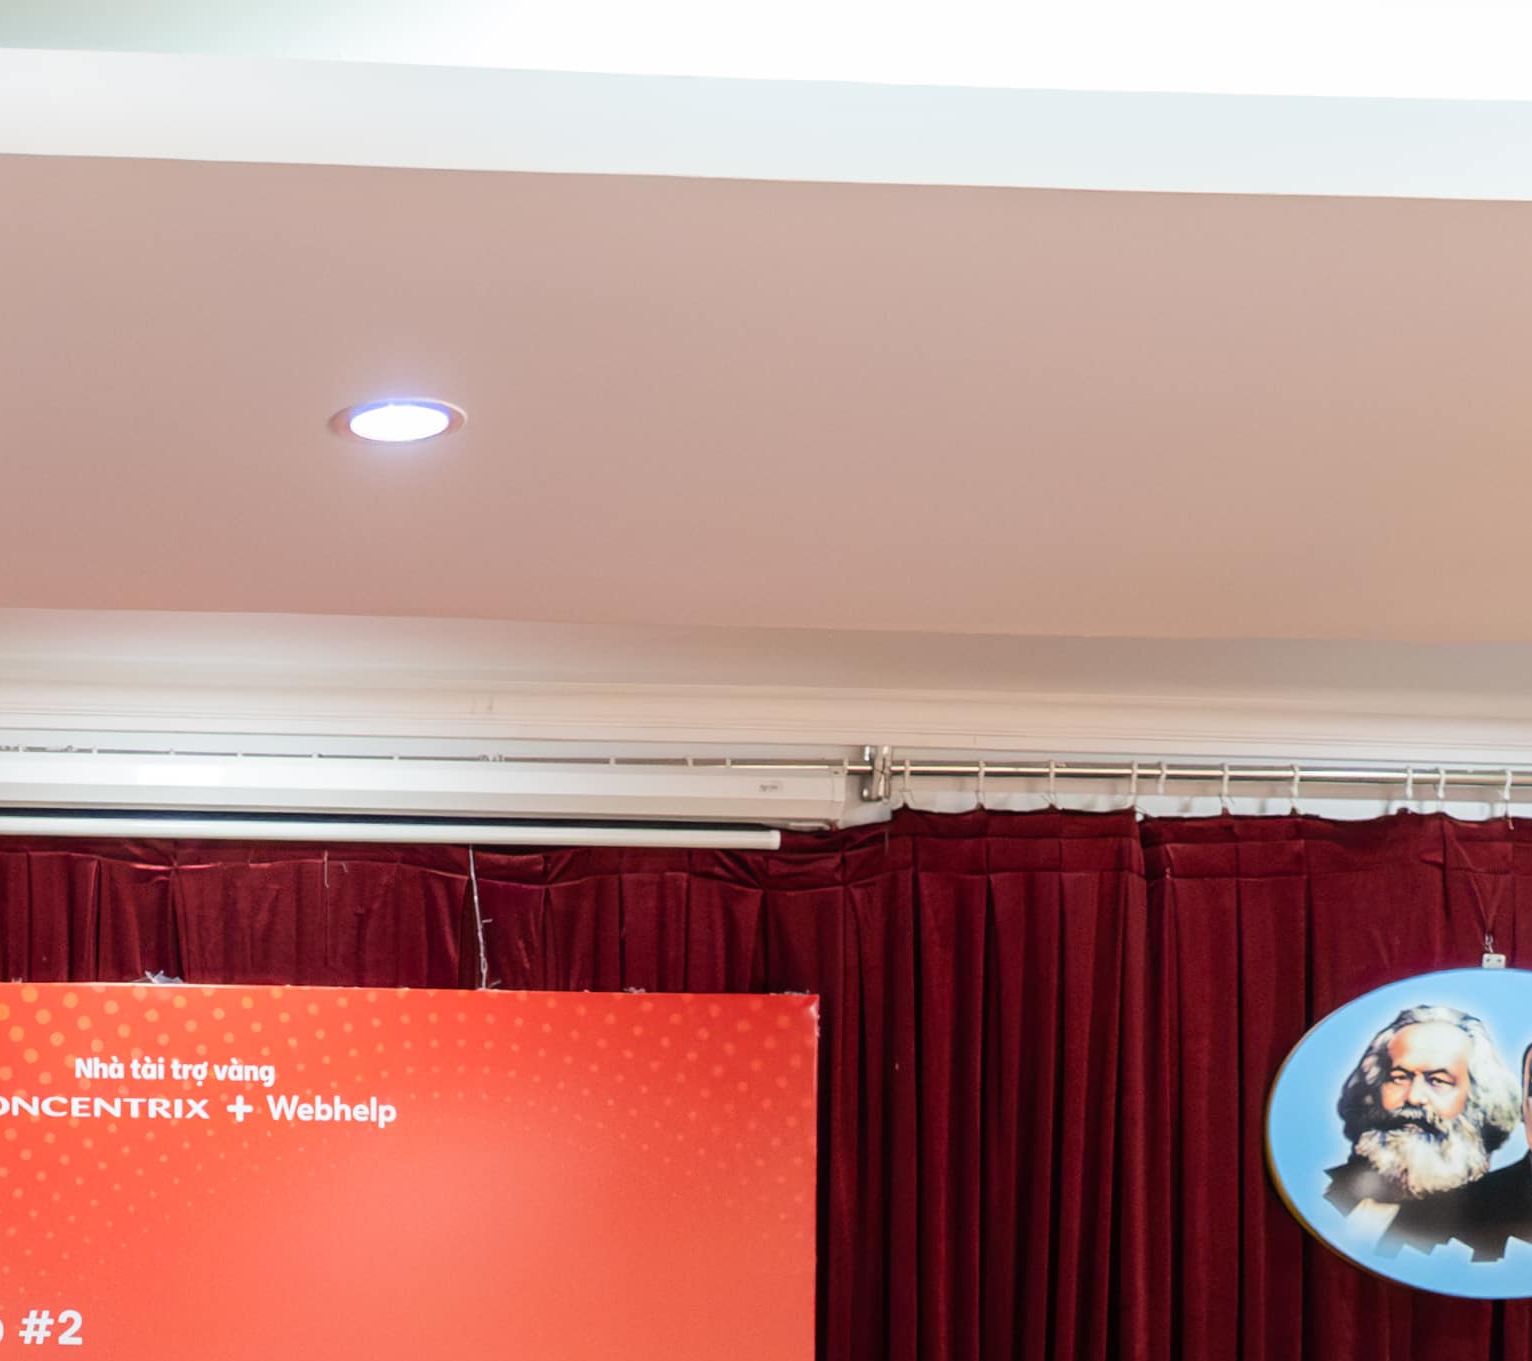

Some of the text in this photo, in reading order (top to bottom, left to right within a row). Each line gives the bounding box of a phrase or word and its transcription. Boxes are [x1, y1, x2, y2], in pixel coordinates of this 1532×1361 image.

[74, 1057, 276, 1086] Nhà tài trợ vàng
[266, 1094, 397, 1128] Webhelp
[18, 1308, 85, 1346] #2
